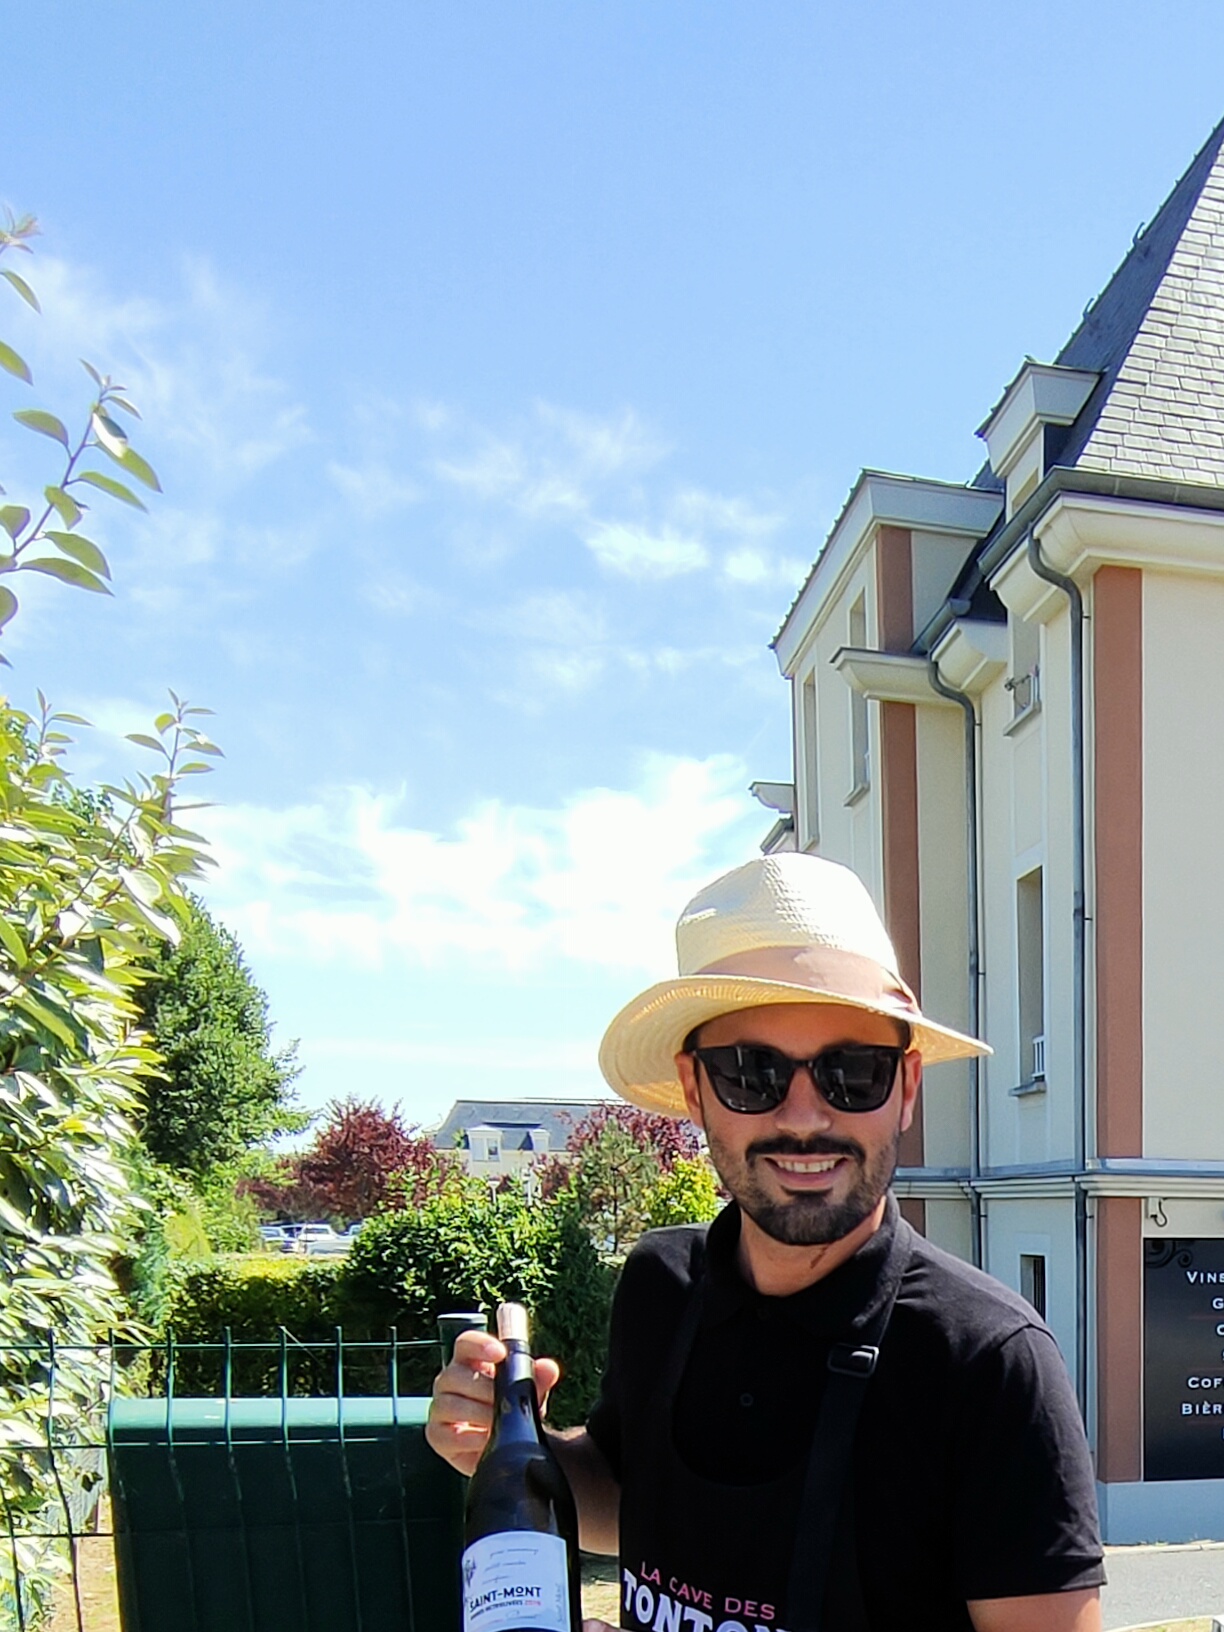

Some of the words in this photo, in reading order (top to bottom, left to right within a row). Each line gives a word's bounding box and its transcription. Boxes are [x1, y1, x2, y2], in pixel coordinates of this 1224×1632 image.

[469, 1585, 542, 1613] SAINT-MONT
[640, 1561, 662, 1586] LA
[668, 1576, 713, 1610] CAVE
[724, 1597, 776, 1621] DES
